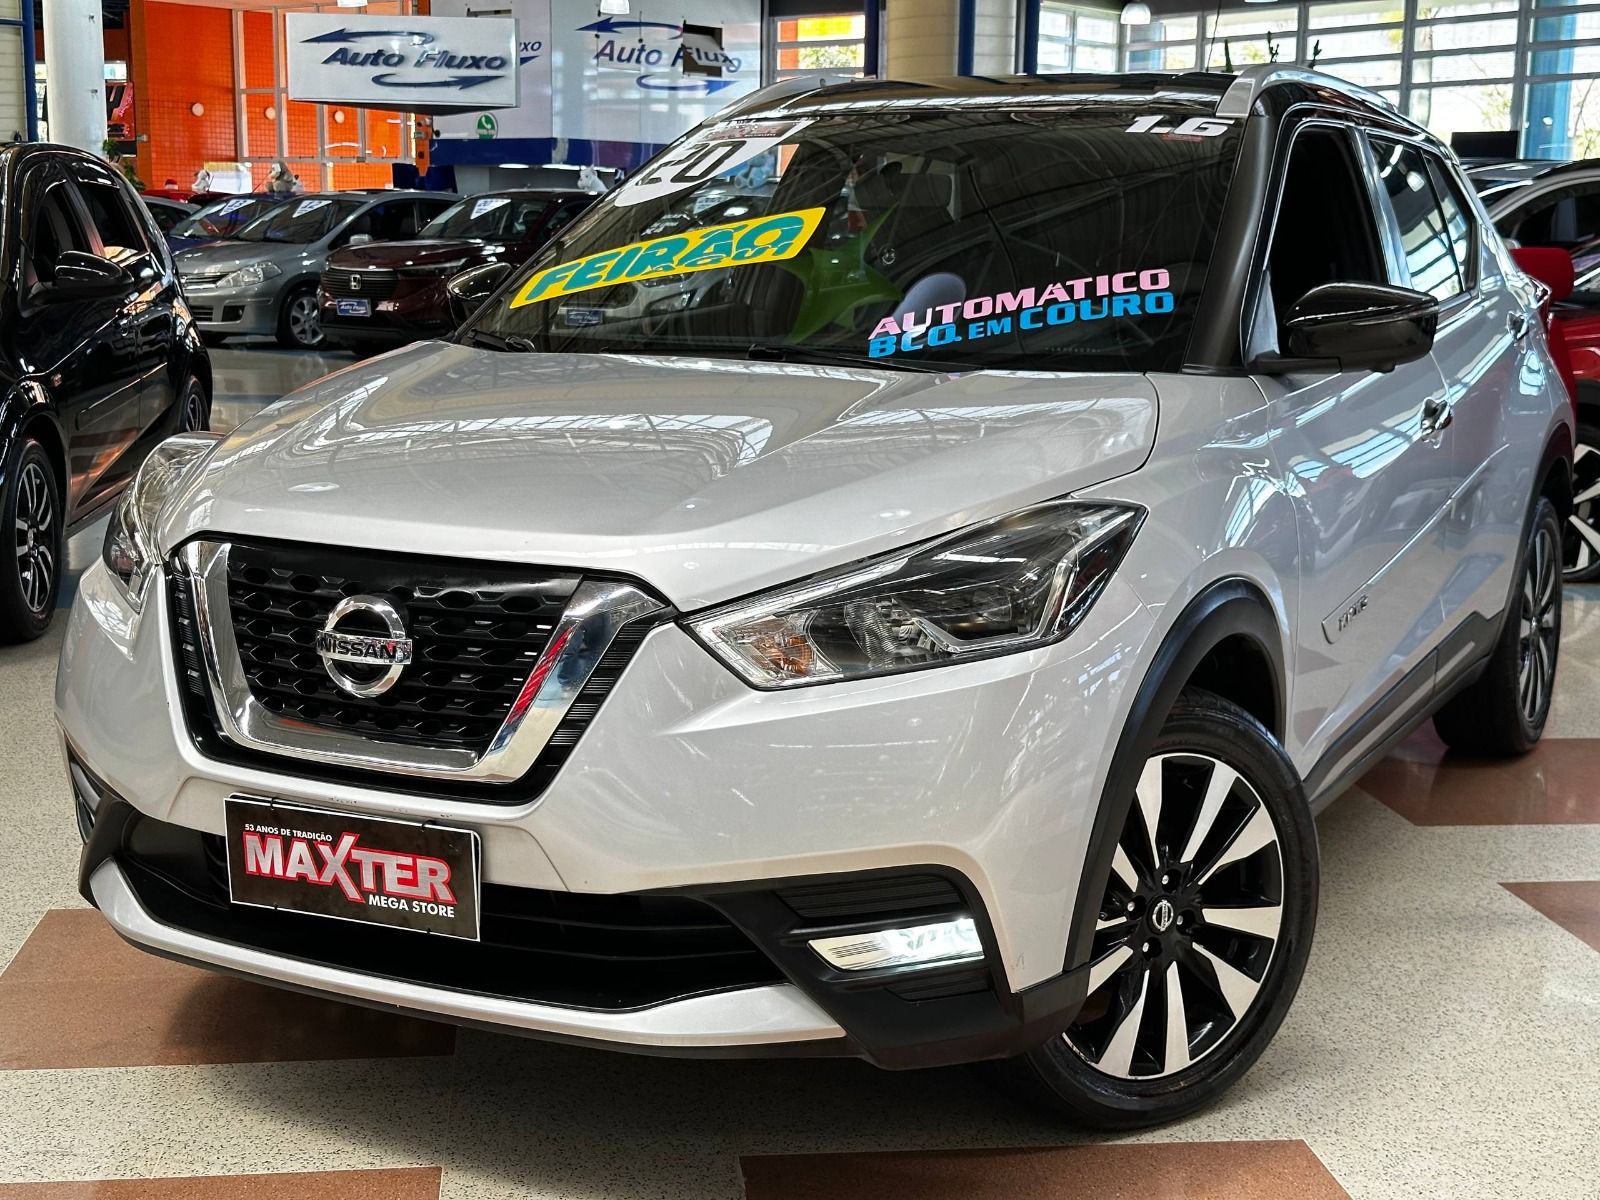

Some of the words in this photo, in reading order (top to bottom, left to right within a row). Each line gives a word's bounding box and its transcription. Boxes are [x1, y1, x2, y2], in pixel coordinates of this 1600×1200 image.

[320, 47, 405, 67] Auto
[412, 49, 507, 71] Fluxo
[593, 39, 662, 66] Auto
[670, 43, 741, 74] Fluxo
[1124, 114, 1235, 137] 1.6
[968, 316, 1011, 340] EM
[1019, 291, 1175, 330] COURO
[319, 634, 399, 661] NISSAN
[245, 823, 255, 832] 53
[256, 825, 279, 835] ANOS
[280, 828, 292, 837] DE
[292, 830, 333, 842] TRADIÇÃO
[243, 832, 457, 903] MAXTER
[368, 894, 409, 911] MEGA
[412, 900, 455, 918] STORE
